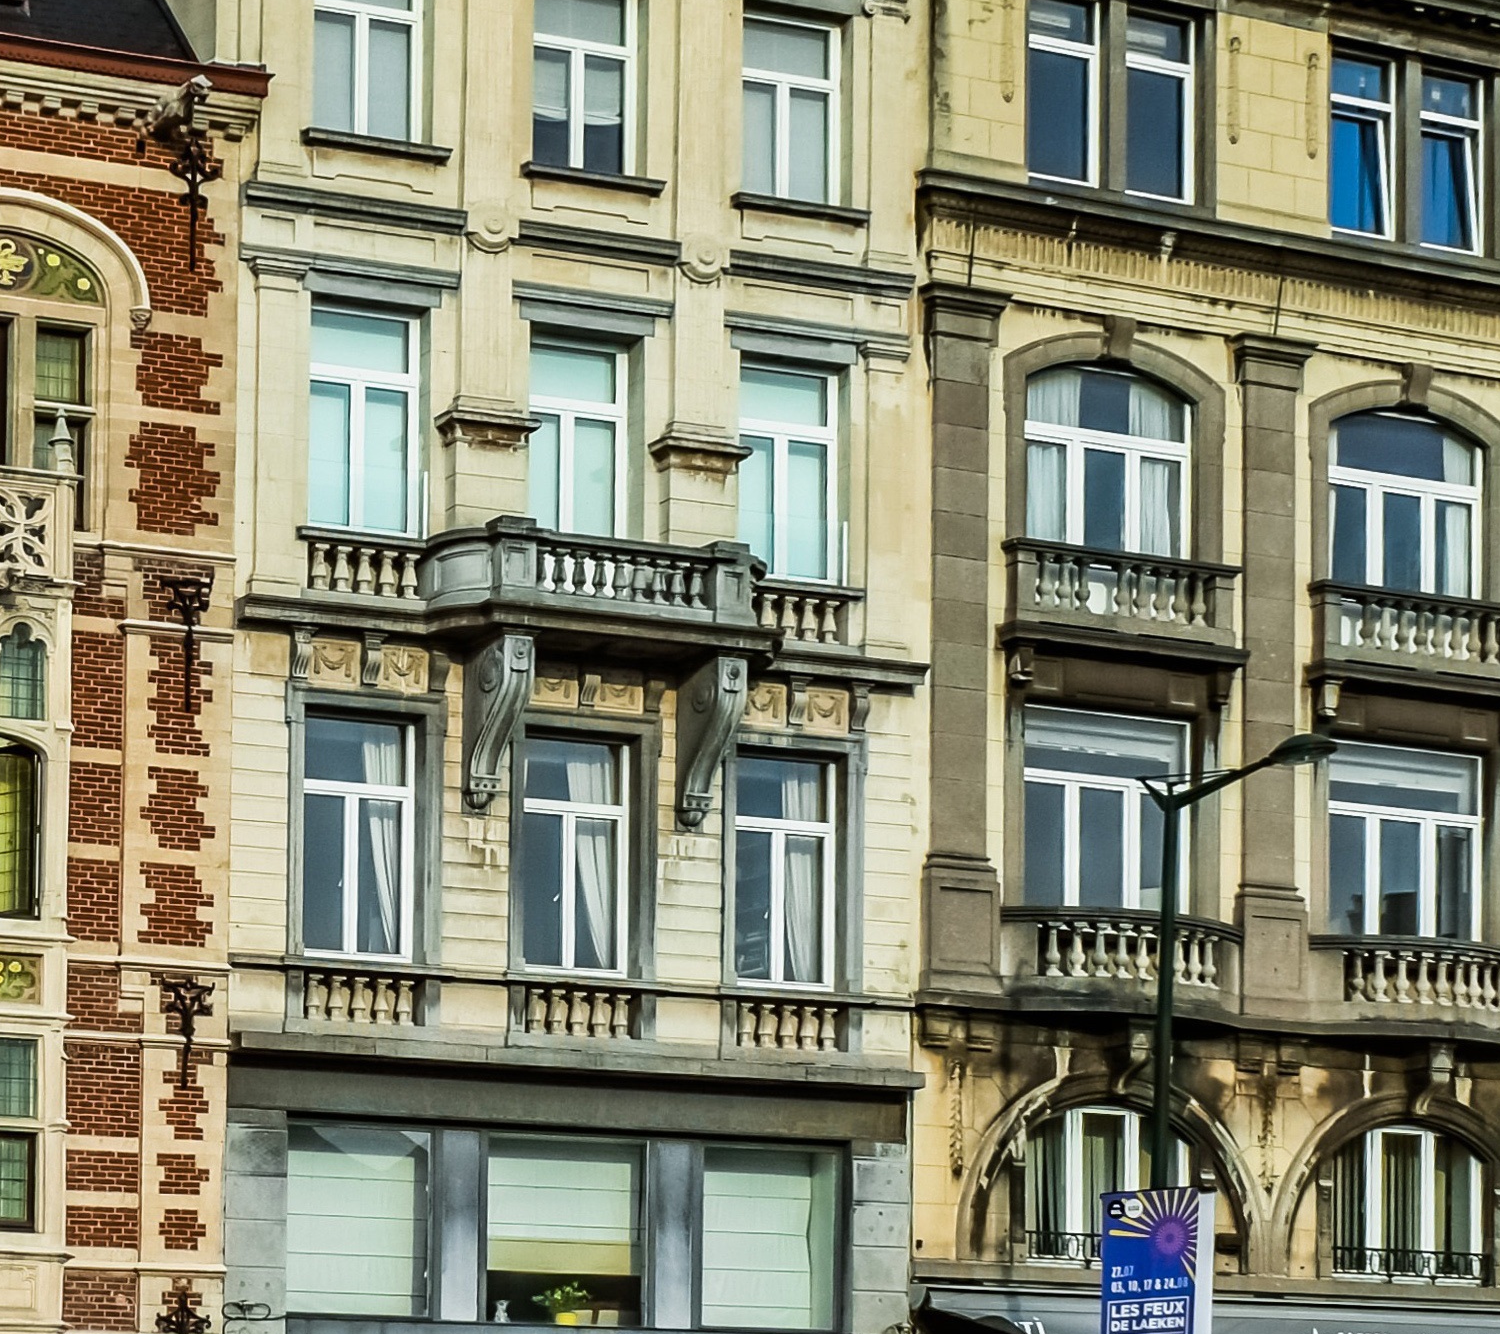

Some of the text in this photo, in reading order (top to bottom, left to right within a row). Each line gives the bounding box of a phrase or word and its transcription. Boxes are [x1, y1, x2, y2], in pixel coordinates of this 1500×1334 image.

[1154, 1278, 1162, 1291] &
[1111, 1300, 1185, 1319] LES FEUX
[1111, 1316, 1185, 1332] DE LAEKEN
